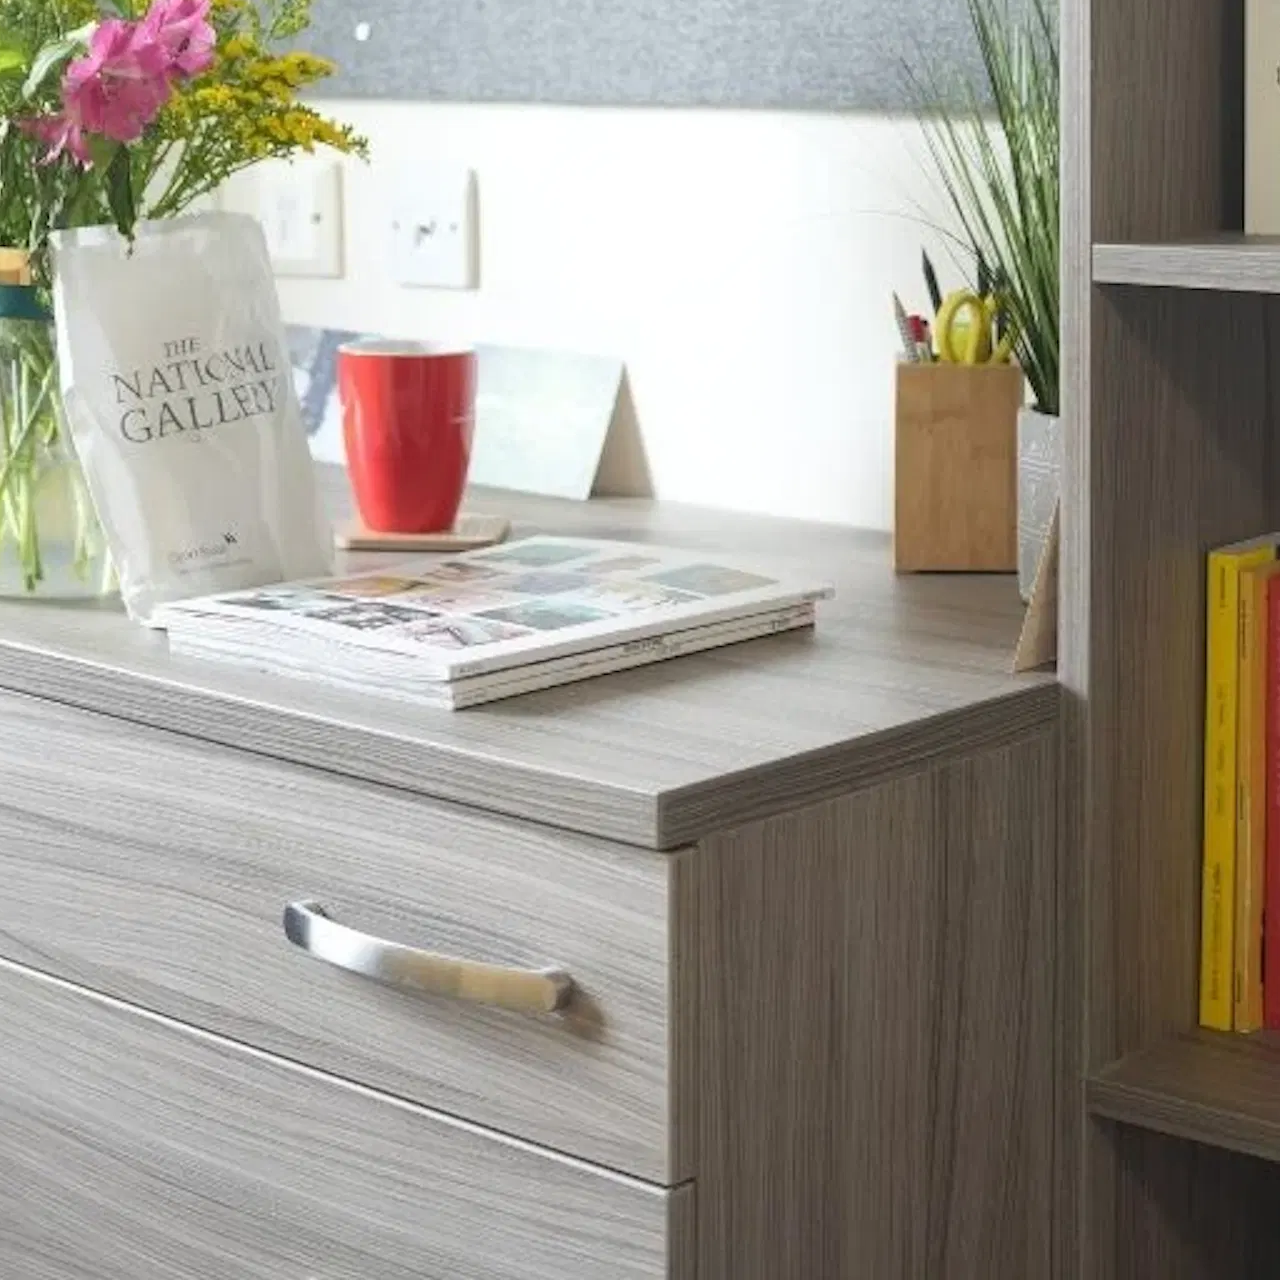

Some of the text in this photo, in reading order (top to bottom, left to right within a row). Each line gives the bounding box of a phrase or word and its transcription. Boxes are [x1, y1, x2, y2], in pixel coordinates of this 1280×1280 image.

[109, 341, 277, 404] NATIONAL
[163, 336, 202, 359] THE
[118, 376, 278, 444] GALLERY
